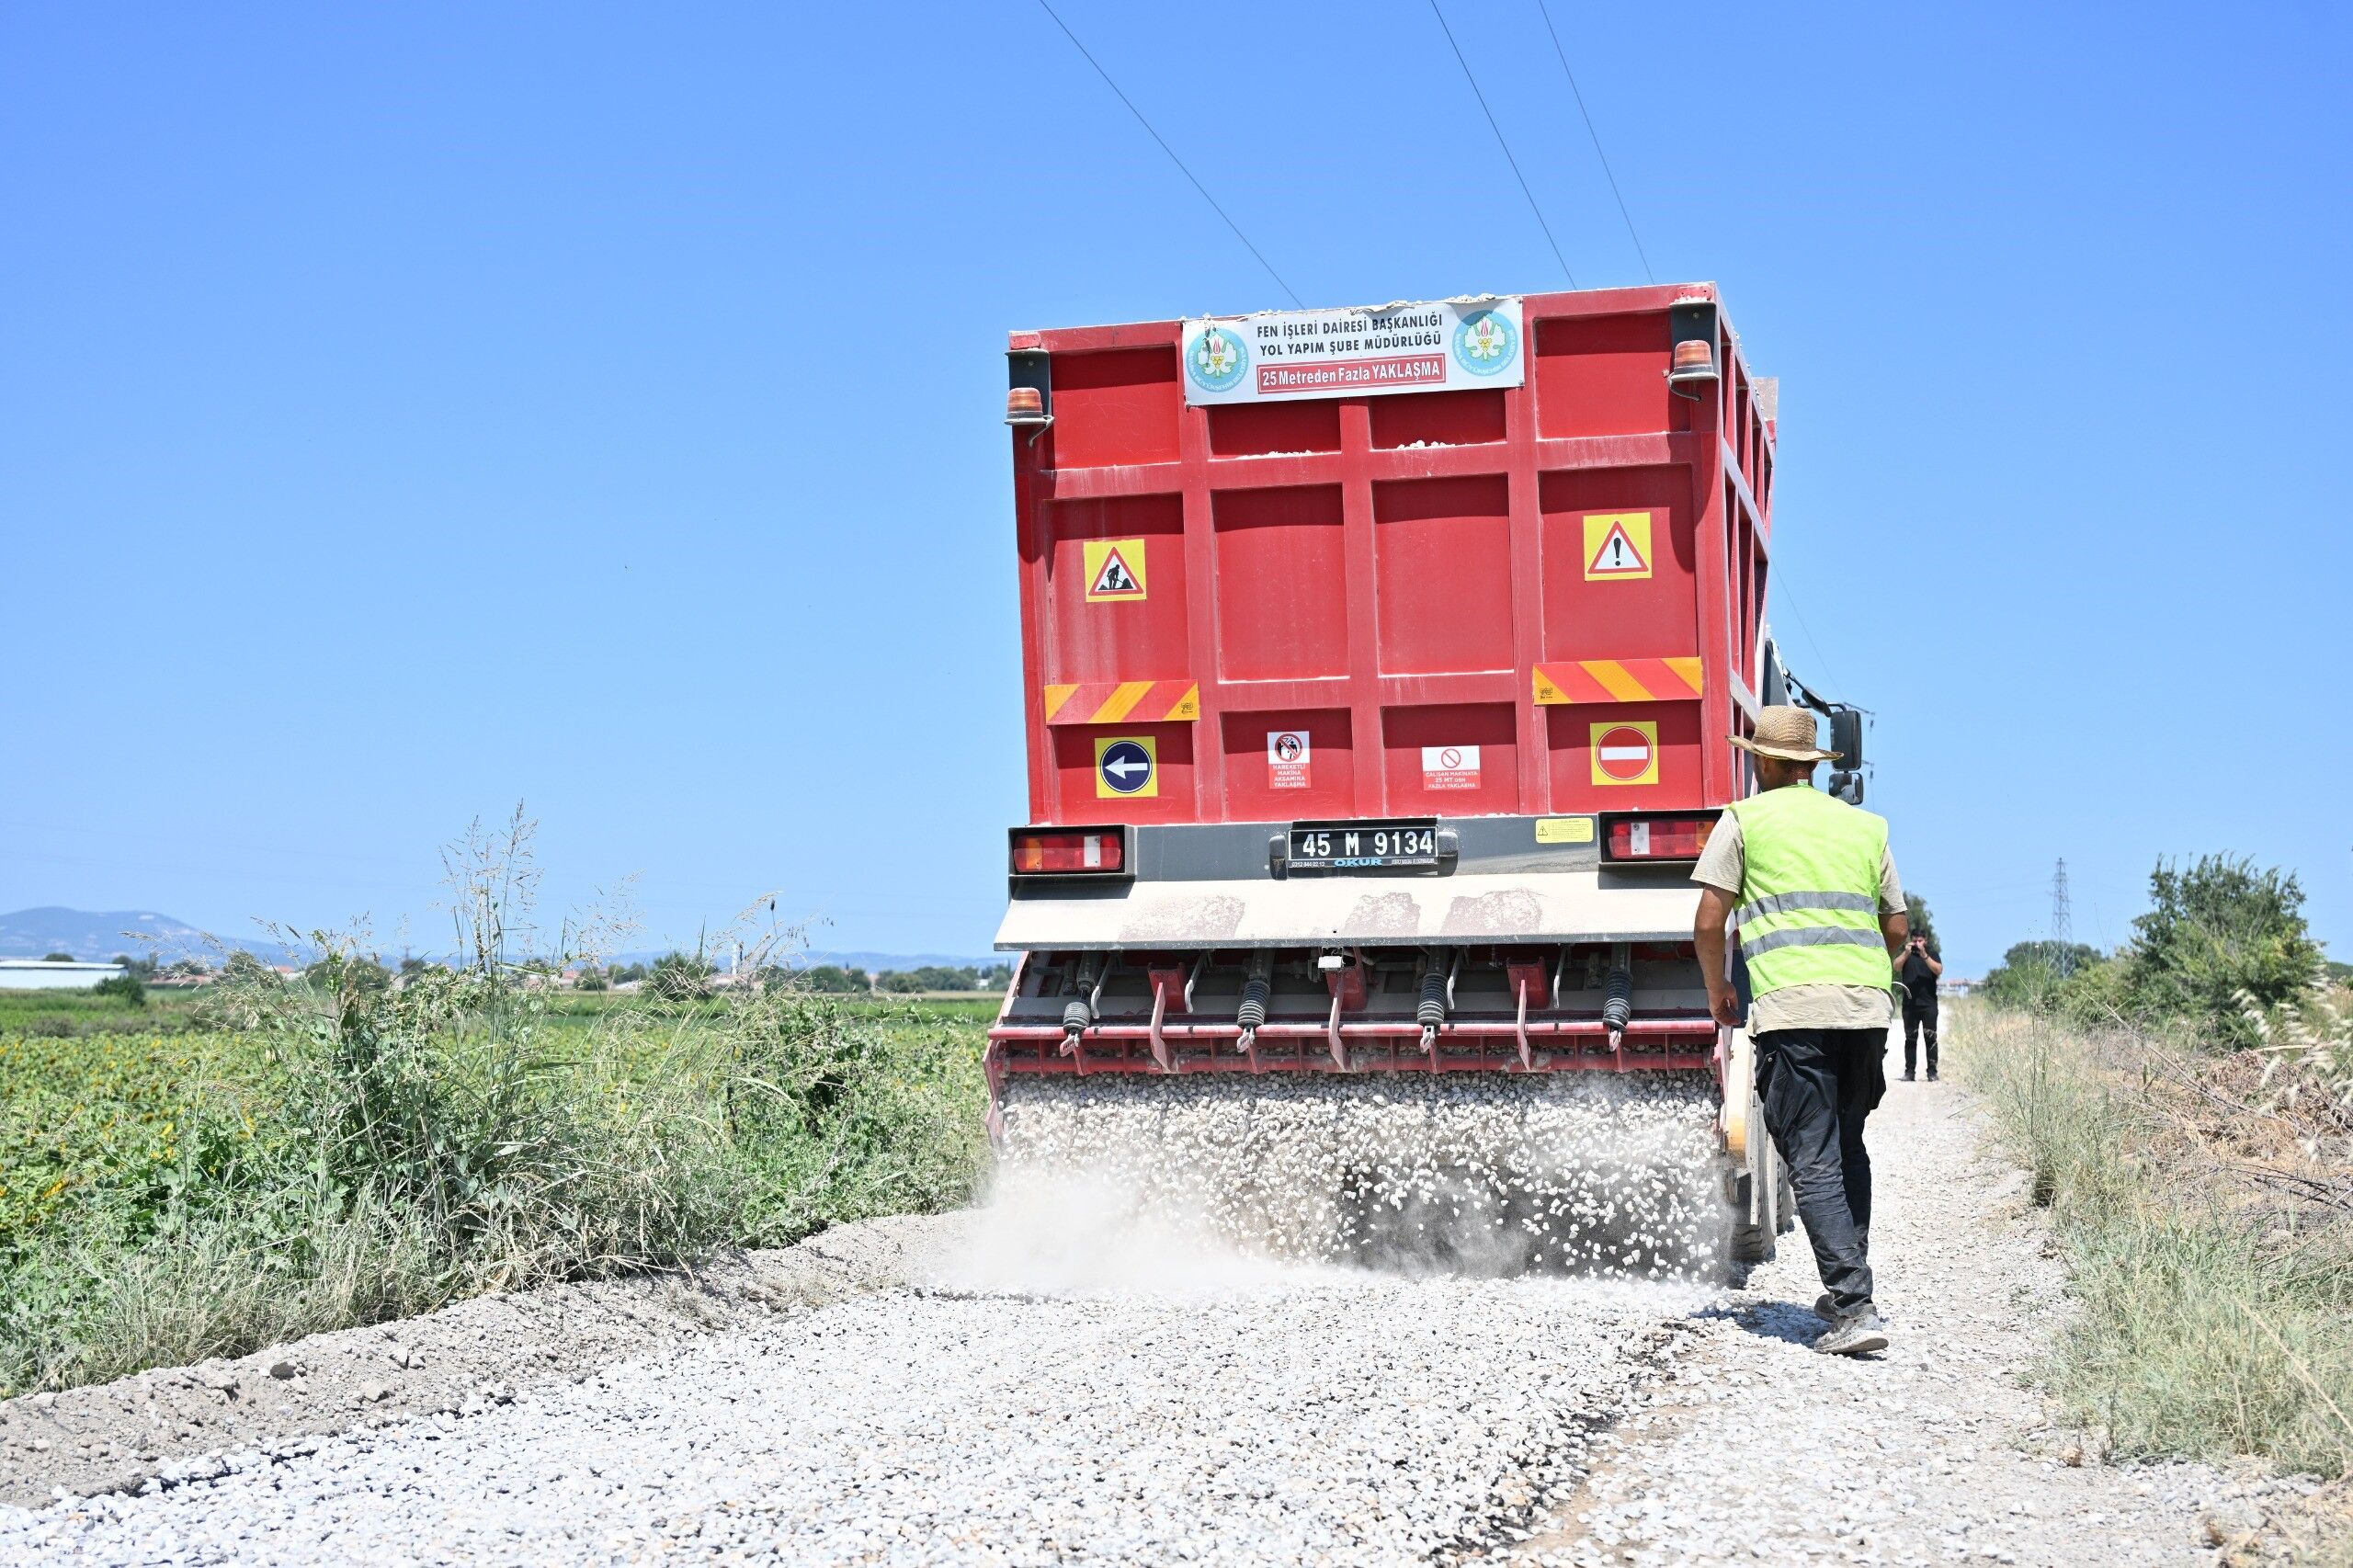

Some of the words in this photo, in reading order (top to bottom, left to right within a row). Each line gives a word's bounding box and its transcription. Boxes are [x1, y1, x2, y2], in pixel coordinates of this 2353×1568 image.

[1257, 325, 1279, 338] FEN
[1283, 319, 1318, 340] İŞLERİ
[1323, 316, 1368, 335] DAİRESİ
[1372, 312, 1442, 333] BAŞKANLIĞI
[1260, 345, 1283, 357] YOL
[1288, 342, 1324, 355] YAPIM
[1330, 339, 1359, 355] ŞUBE
[1364, 331, 1441, 350] MÜDÜRLÜĞÜ
[1262, 374, 1277, 387] 25
[1279, 369, 1336, 385] Metreden
[1338, 367, 1370, 382] Fazla
[1372, 360, 1440, 381] YAKLAŞMA
[1302, 833, 1331, 857] 45
[1345, 832, 1359, 856] M
[1374, 830, 1434, 856] 9134
[1334, 859, 1382, 868] OKUR
